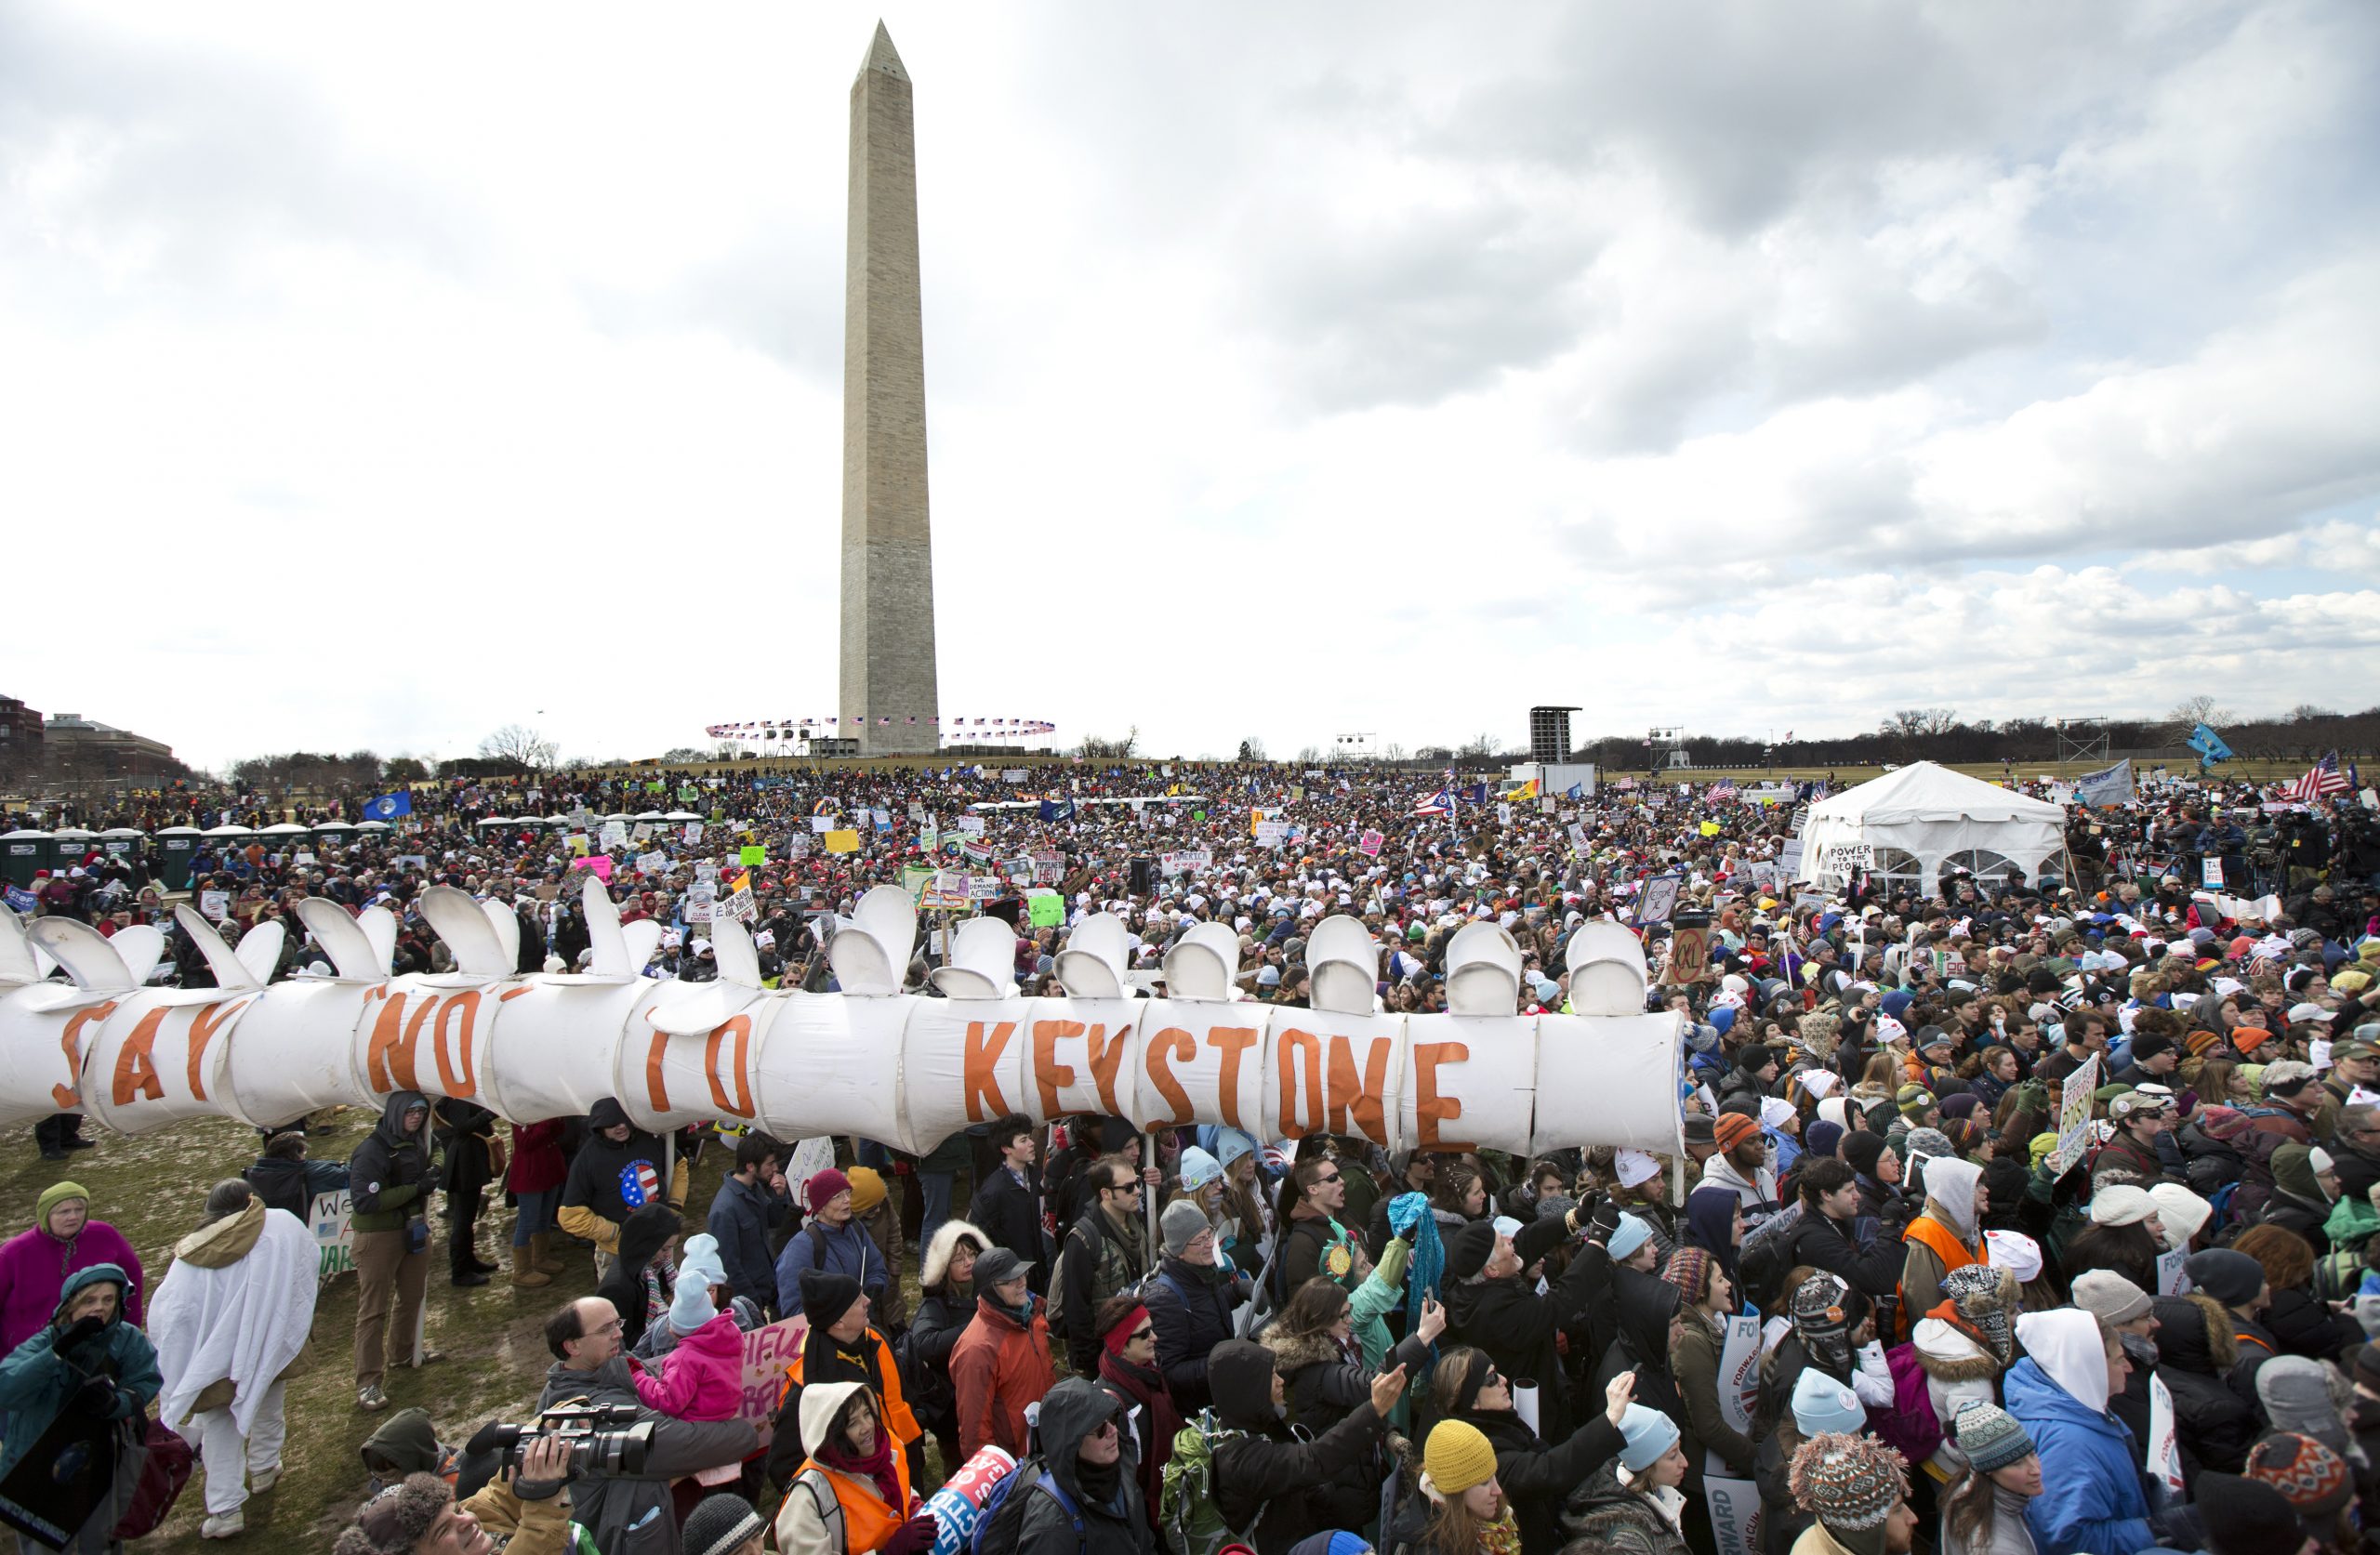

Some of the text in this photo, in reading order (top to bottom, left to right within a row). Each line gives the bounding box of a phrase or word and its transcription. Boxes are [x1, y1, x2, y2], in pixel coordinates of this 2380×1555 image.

[1173, 852, 1208, 861] AMERICA
[1830, 844, 1871, 857] POWER
[1173, 863, 1201, 871] STOP
[1832, 861, 1870, 872] PEOPLE
[1038, 869, 1057, 881] HELL
[970, 890, 995, 898] ACTION
[51, 1000, 248, 1109] SAY
[963, 1019, 1476, 1153] KEYSTONE
[2061, 1089, 2094, 1133] POISON
[1915, 1160, 1926, 1169] FO
[319, 1193, 353, 1218] We
[1745, 1206, 1799, 1247] FORWARD
